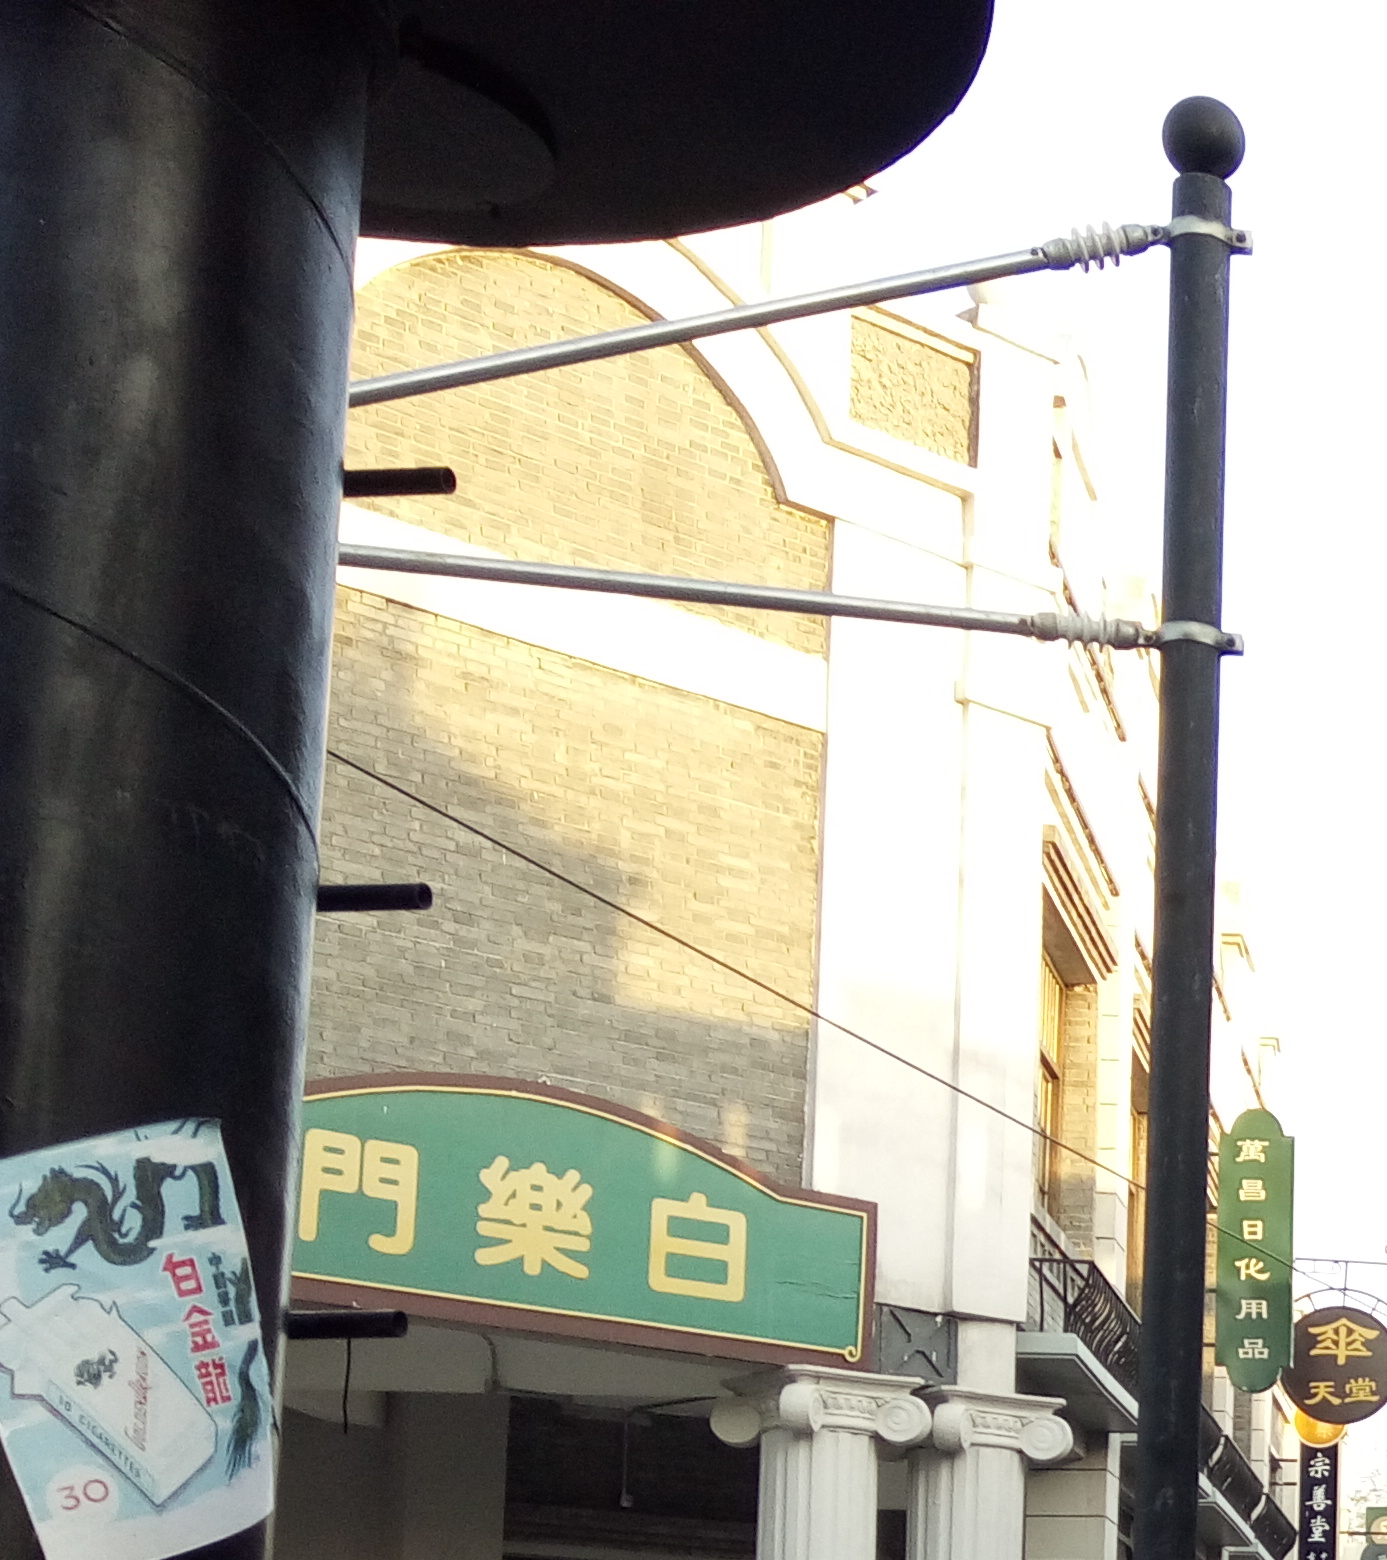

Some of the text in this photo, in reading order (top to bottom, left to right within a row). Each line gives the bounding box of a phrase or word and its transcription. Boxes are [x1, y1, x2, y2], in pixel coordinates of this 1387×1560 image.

[1234, 1139, 1271, 1360] 萬昌日化用品
[1307, 1317, 1381, 1366] 傘
[1304, 1377, 1381, 1405] 天堂
[56, 1478, 110, 1511] 30
